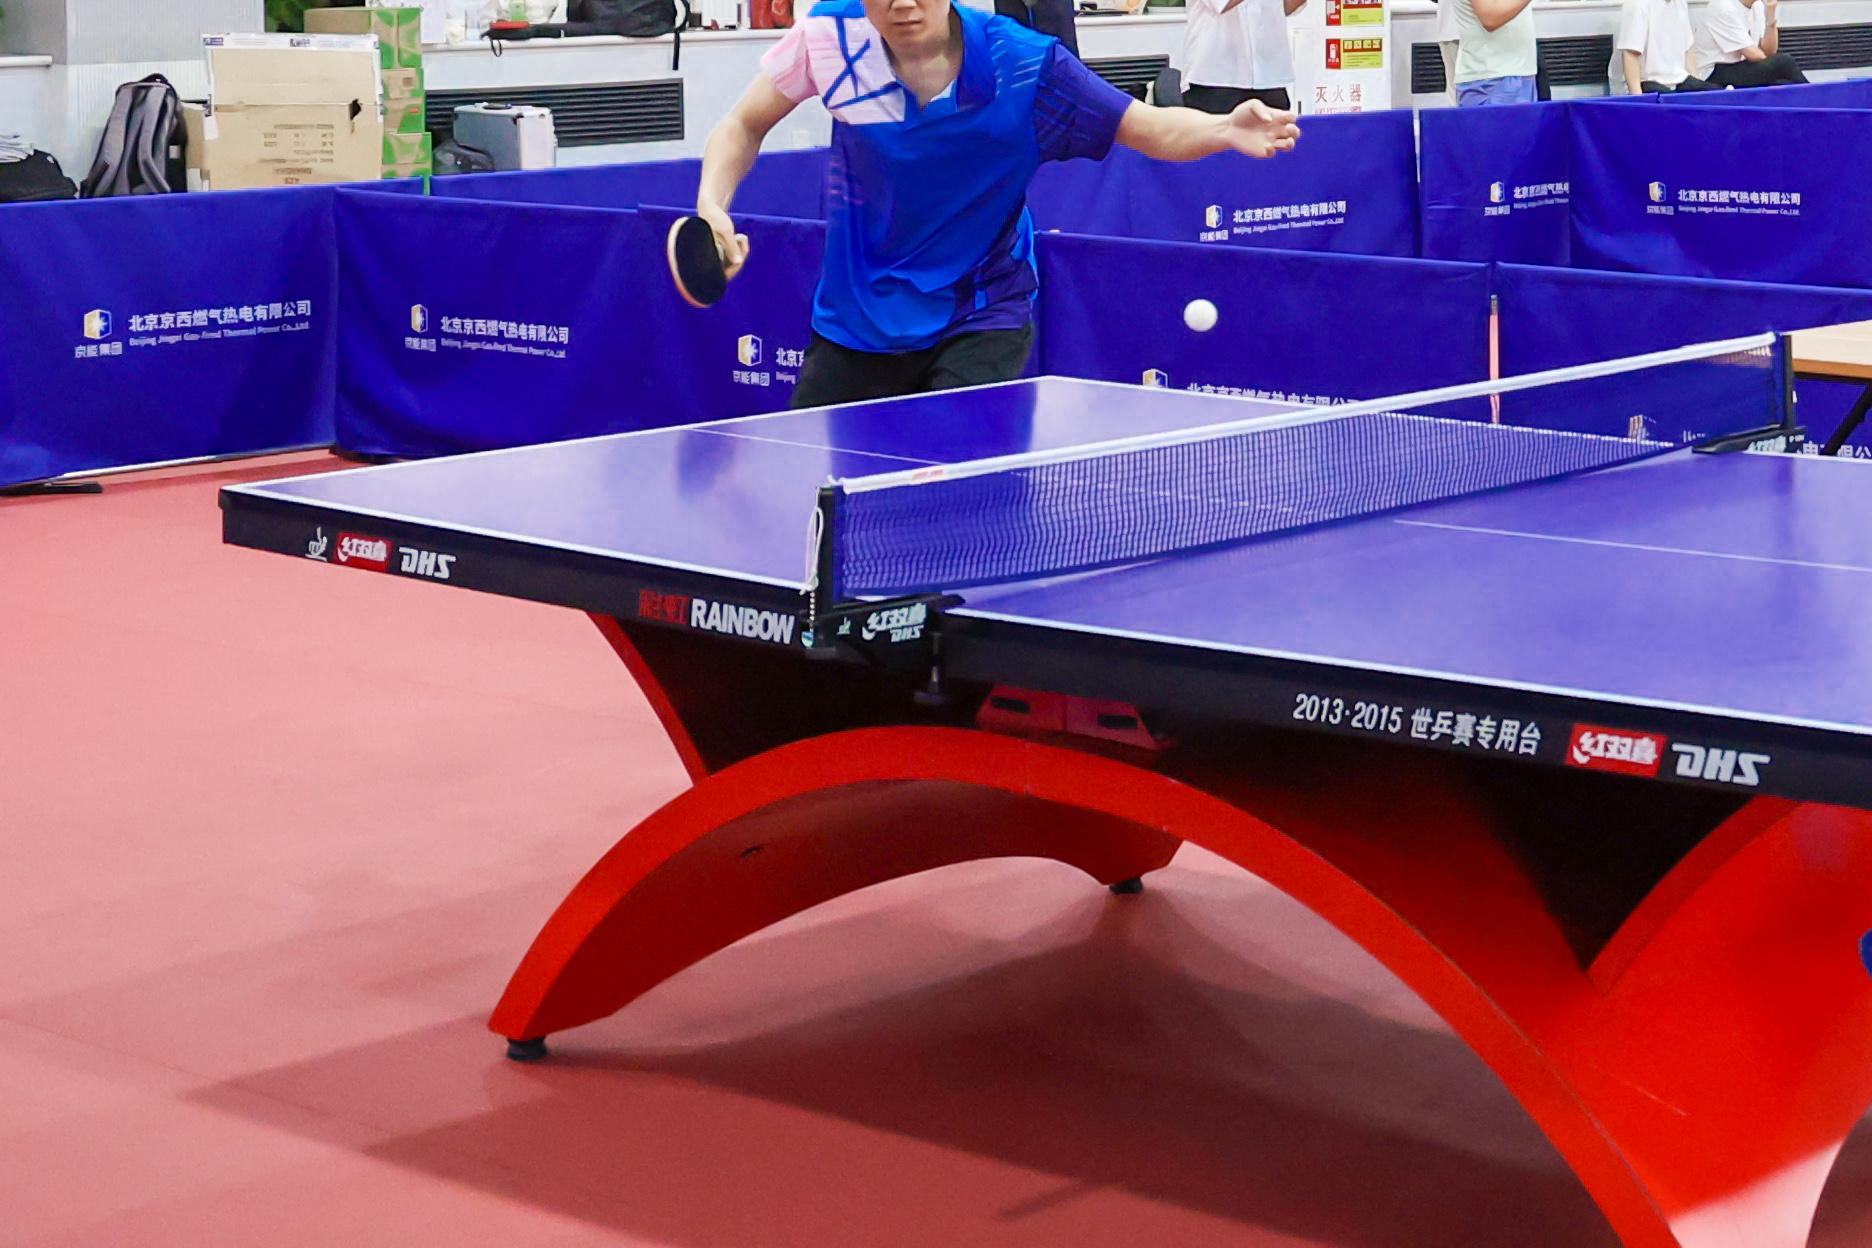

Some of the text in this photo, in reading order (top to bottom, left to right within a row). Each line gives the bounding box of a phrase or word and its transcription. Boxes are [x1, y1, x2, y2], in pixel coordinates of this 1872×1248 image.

[1314, 84, 1362, 103] 灭火器
[128, 300, 312, 332] 北京京西燃气热电有限公司
[440, 315, 570, 345] 北京京西燃气热电有限公司
[399, 546, 457, 580] DHS
[690, 597, 796, 645] RAINBOW
[1410, 707, 1542, 756] 世乒赛专用台
[1672, 742, 1770, 786] DHS
